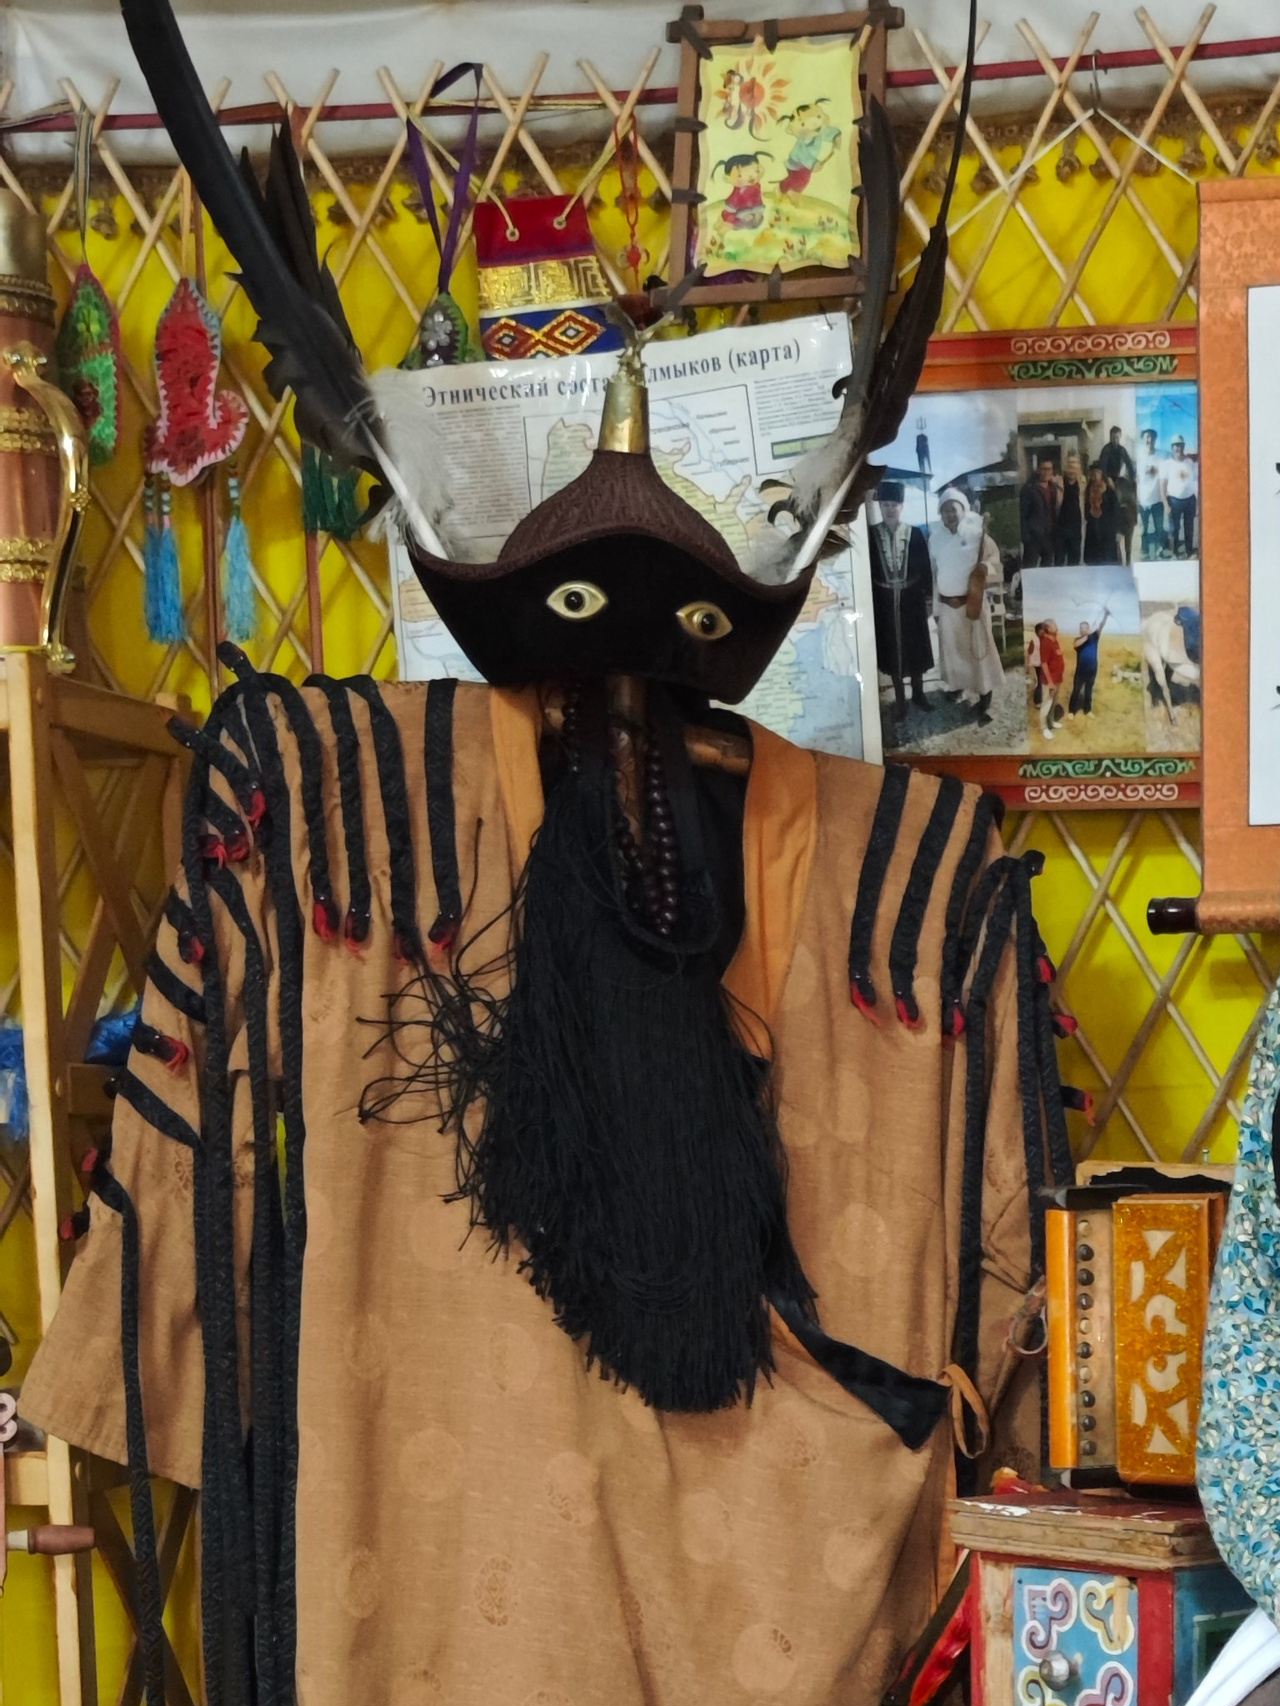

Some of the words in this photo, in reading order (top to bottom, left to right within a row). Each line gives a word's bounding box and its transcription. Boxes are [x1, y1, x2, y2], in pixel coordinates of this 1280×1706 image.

[422, 376, 549, 408] Этнический
[557, 376, 611, 398] соста
[648, 355, 722, 384] лмыков
[728, 339, 801, 374] (карта)
